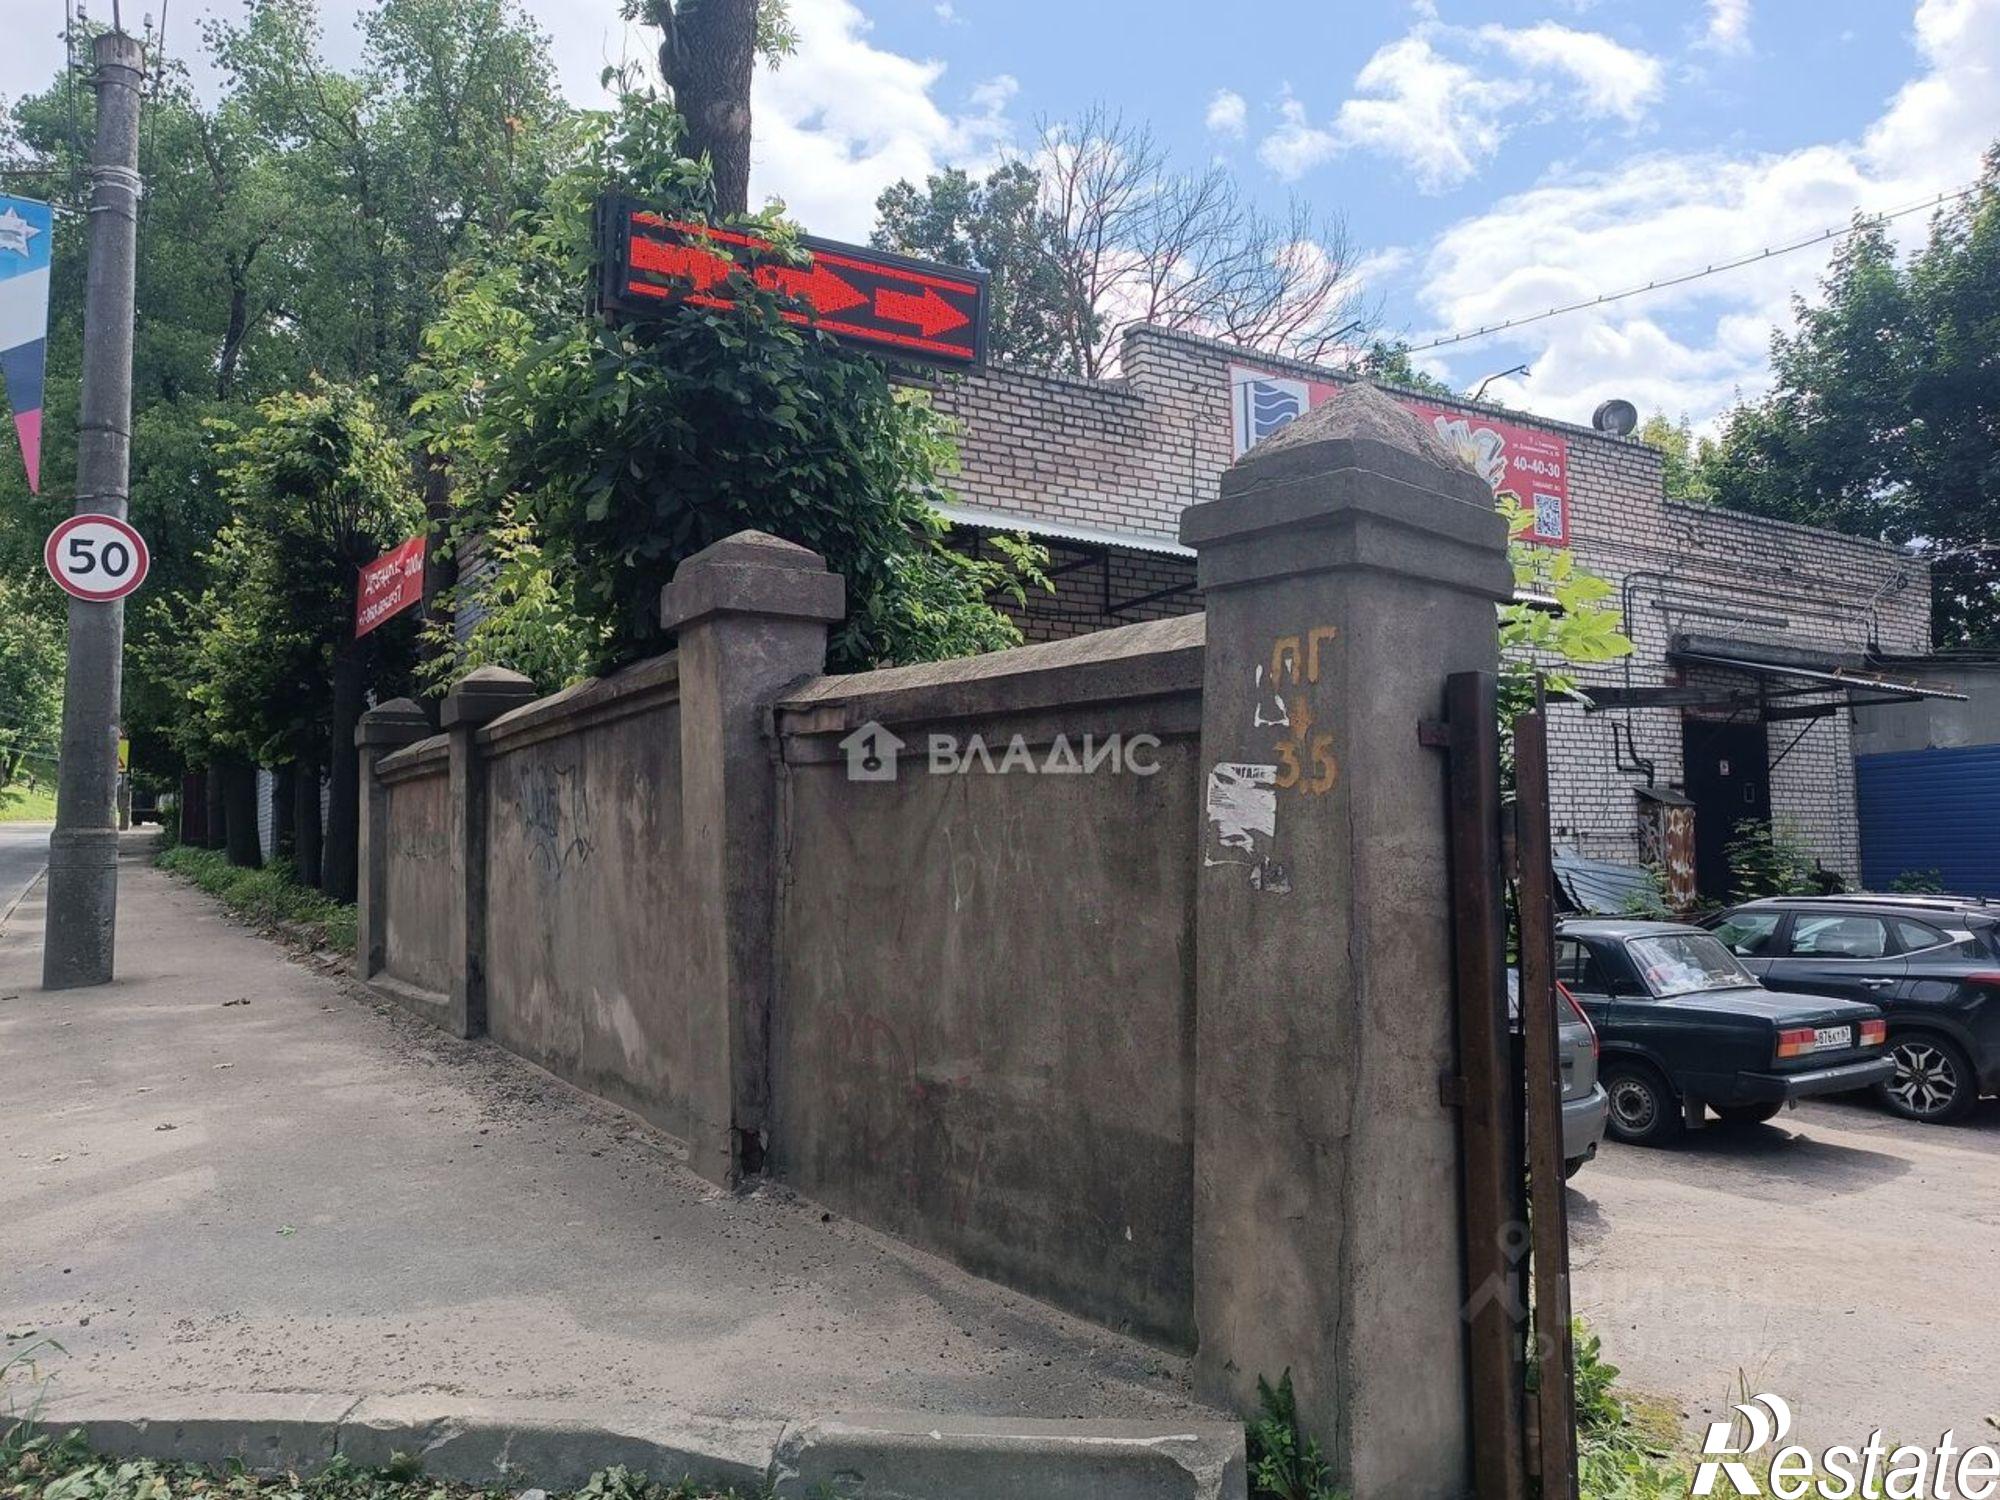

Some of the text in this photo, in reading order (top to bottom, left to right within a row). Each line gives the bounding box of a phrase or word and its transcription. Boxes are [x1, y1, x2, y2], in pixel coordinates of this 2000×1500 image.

[1513, 455, 1560, 478] 40-40-30
[69, 538, 129, 577] 50
[1273, 734, 1337, 796] 35
